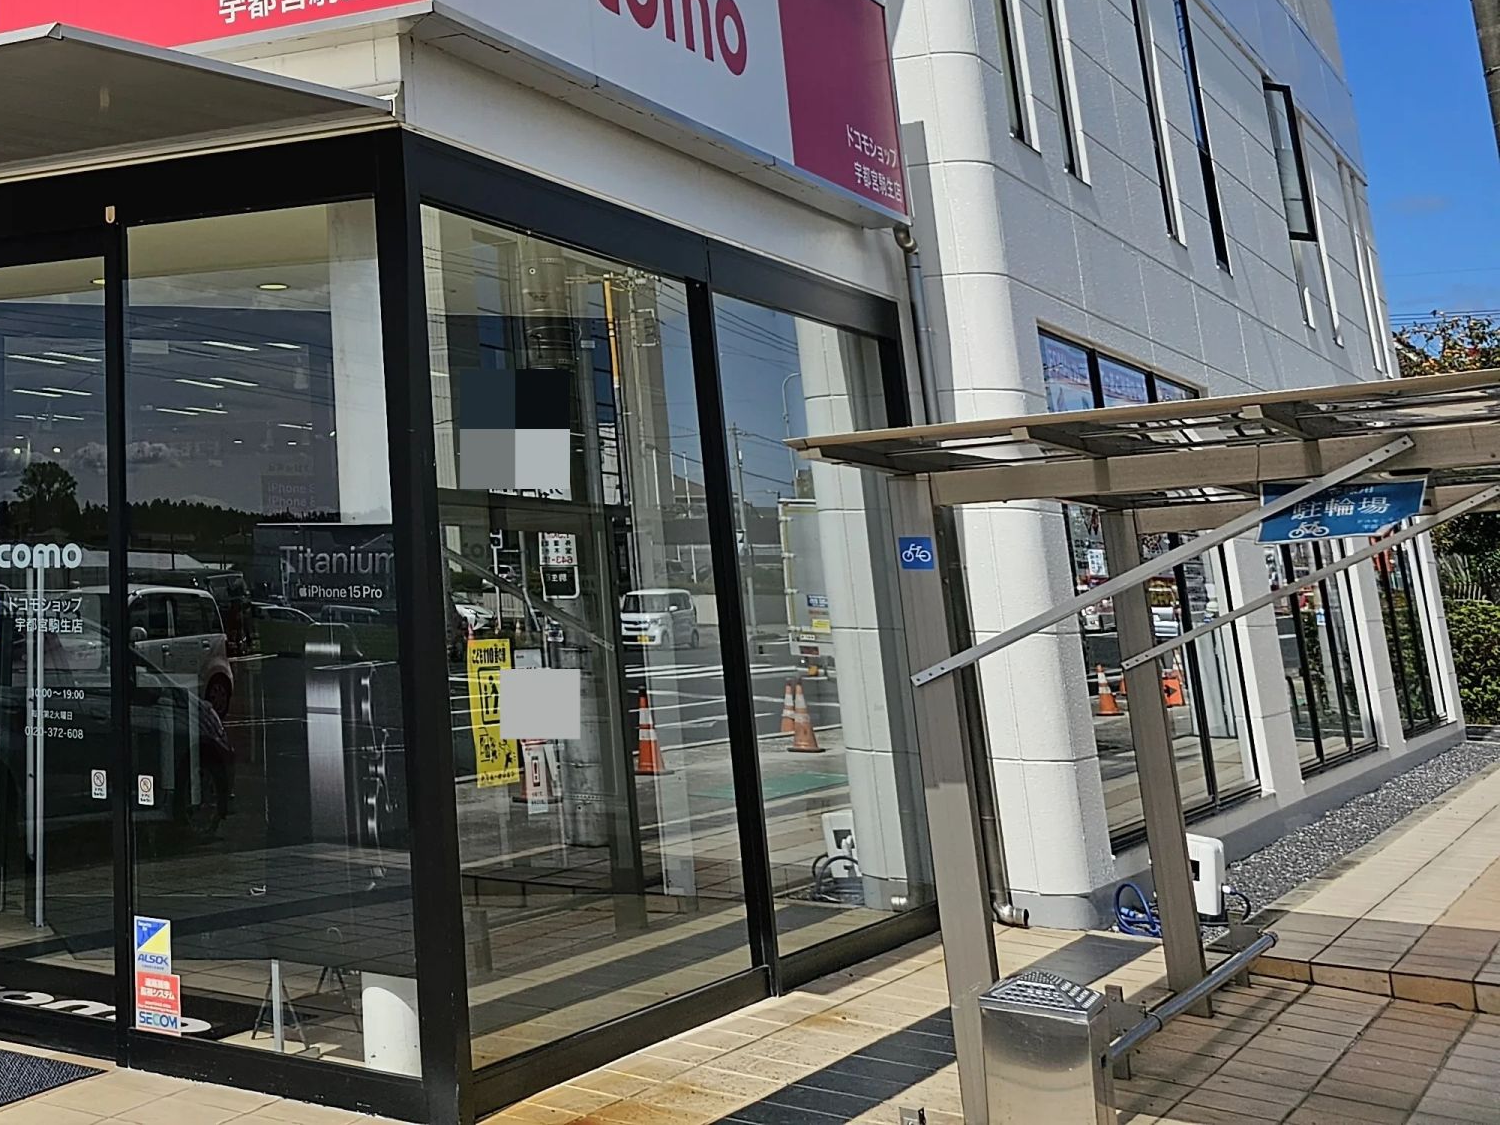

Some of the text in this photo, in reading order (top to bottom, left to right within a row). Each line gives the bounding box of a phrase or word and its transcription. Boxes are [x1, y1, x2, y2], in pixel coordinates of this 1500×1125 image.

[846, 124, 897, 168] ドコモショップ
[854, 161, 902, 202] 宇都宮駒生店
[1291, 497, 1390, 520] 駐輪場
[308, 586, 382, 598] iPhone 15 Pro
[9, 597, 82, 612] ドコモショップ
[15, 618, 83, 633] 宇都宮駒生店
[138, 954, 168, 966] ALSOK
[139, 1011, 178, 1029] SECOM
